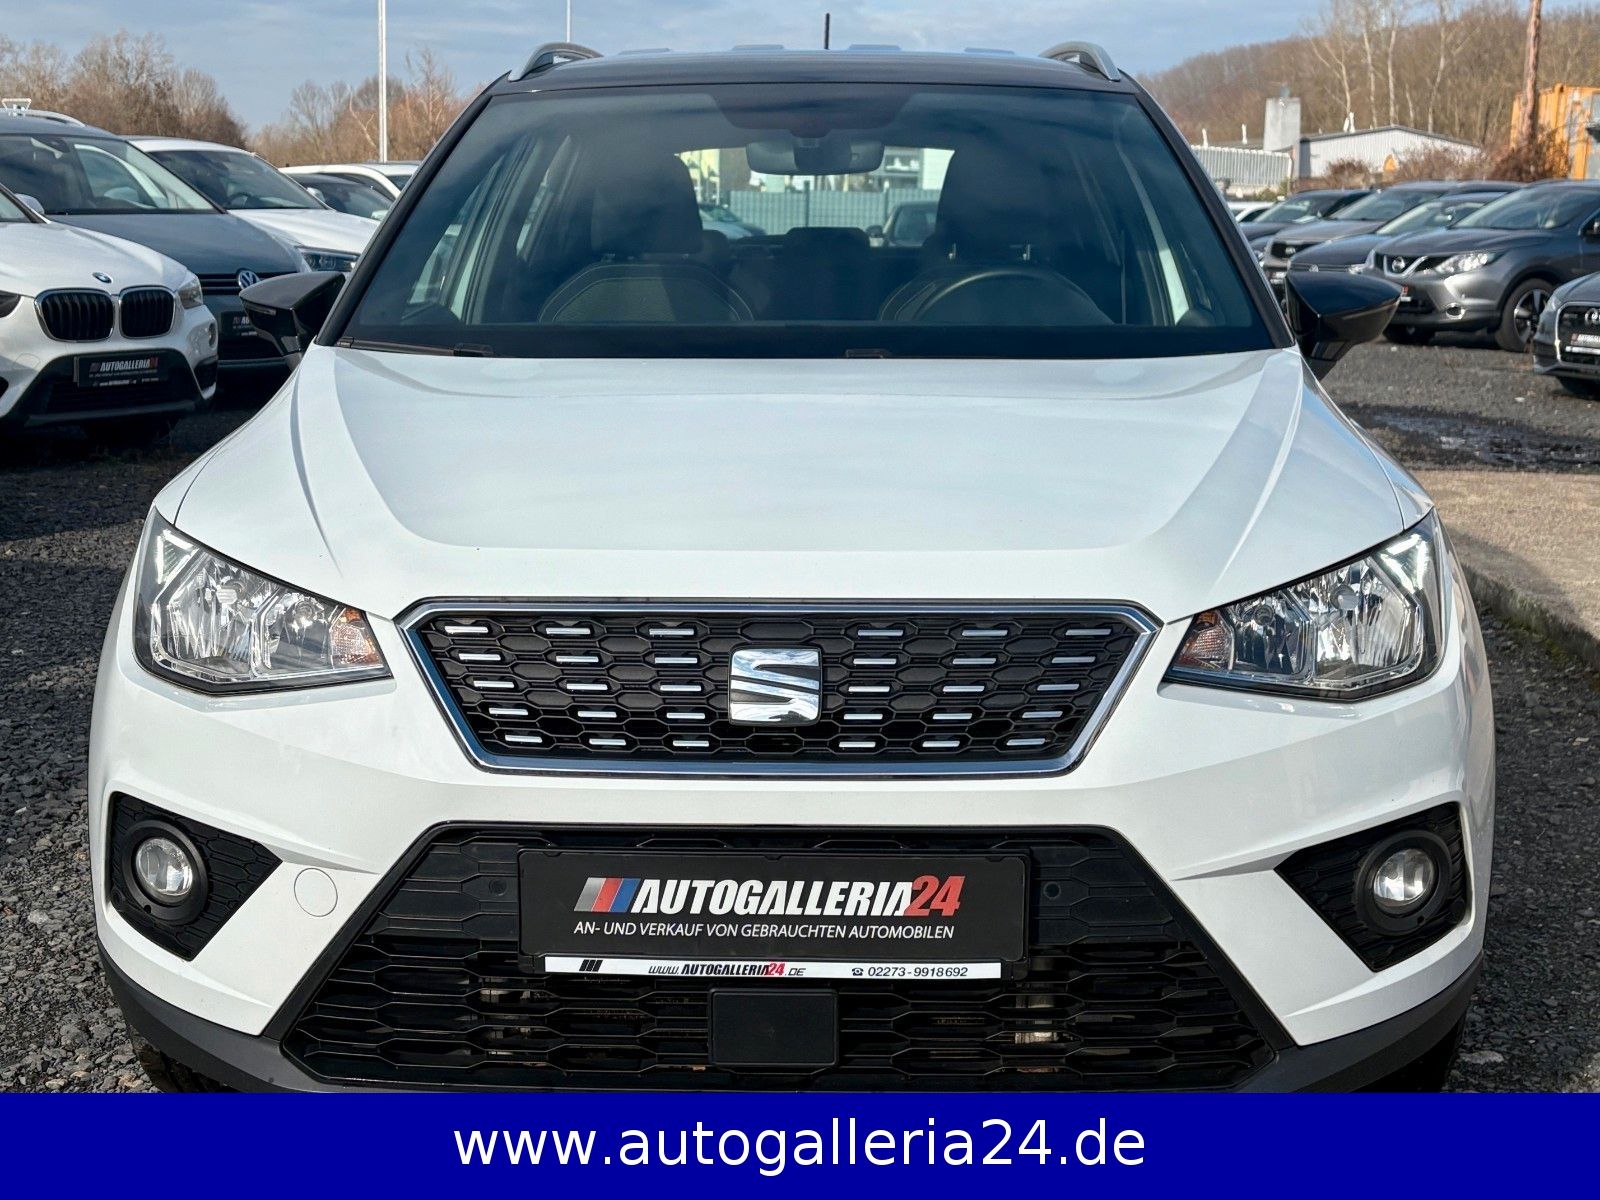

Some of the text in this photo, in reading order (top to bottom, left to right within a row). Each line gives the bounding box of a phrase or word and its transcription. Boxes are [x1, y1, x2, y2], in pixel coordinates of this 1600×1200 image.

[99, 356, 159, 372] AUTOGALLERIA
[630, 875, 965, 917] AUTOGALLERIA24
[573, 921, 955, 939] AN- UND VERKAUF VON GEBRAUCHTEN AUTOMOBILEN
